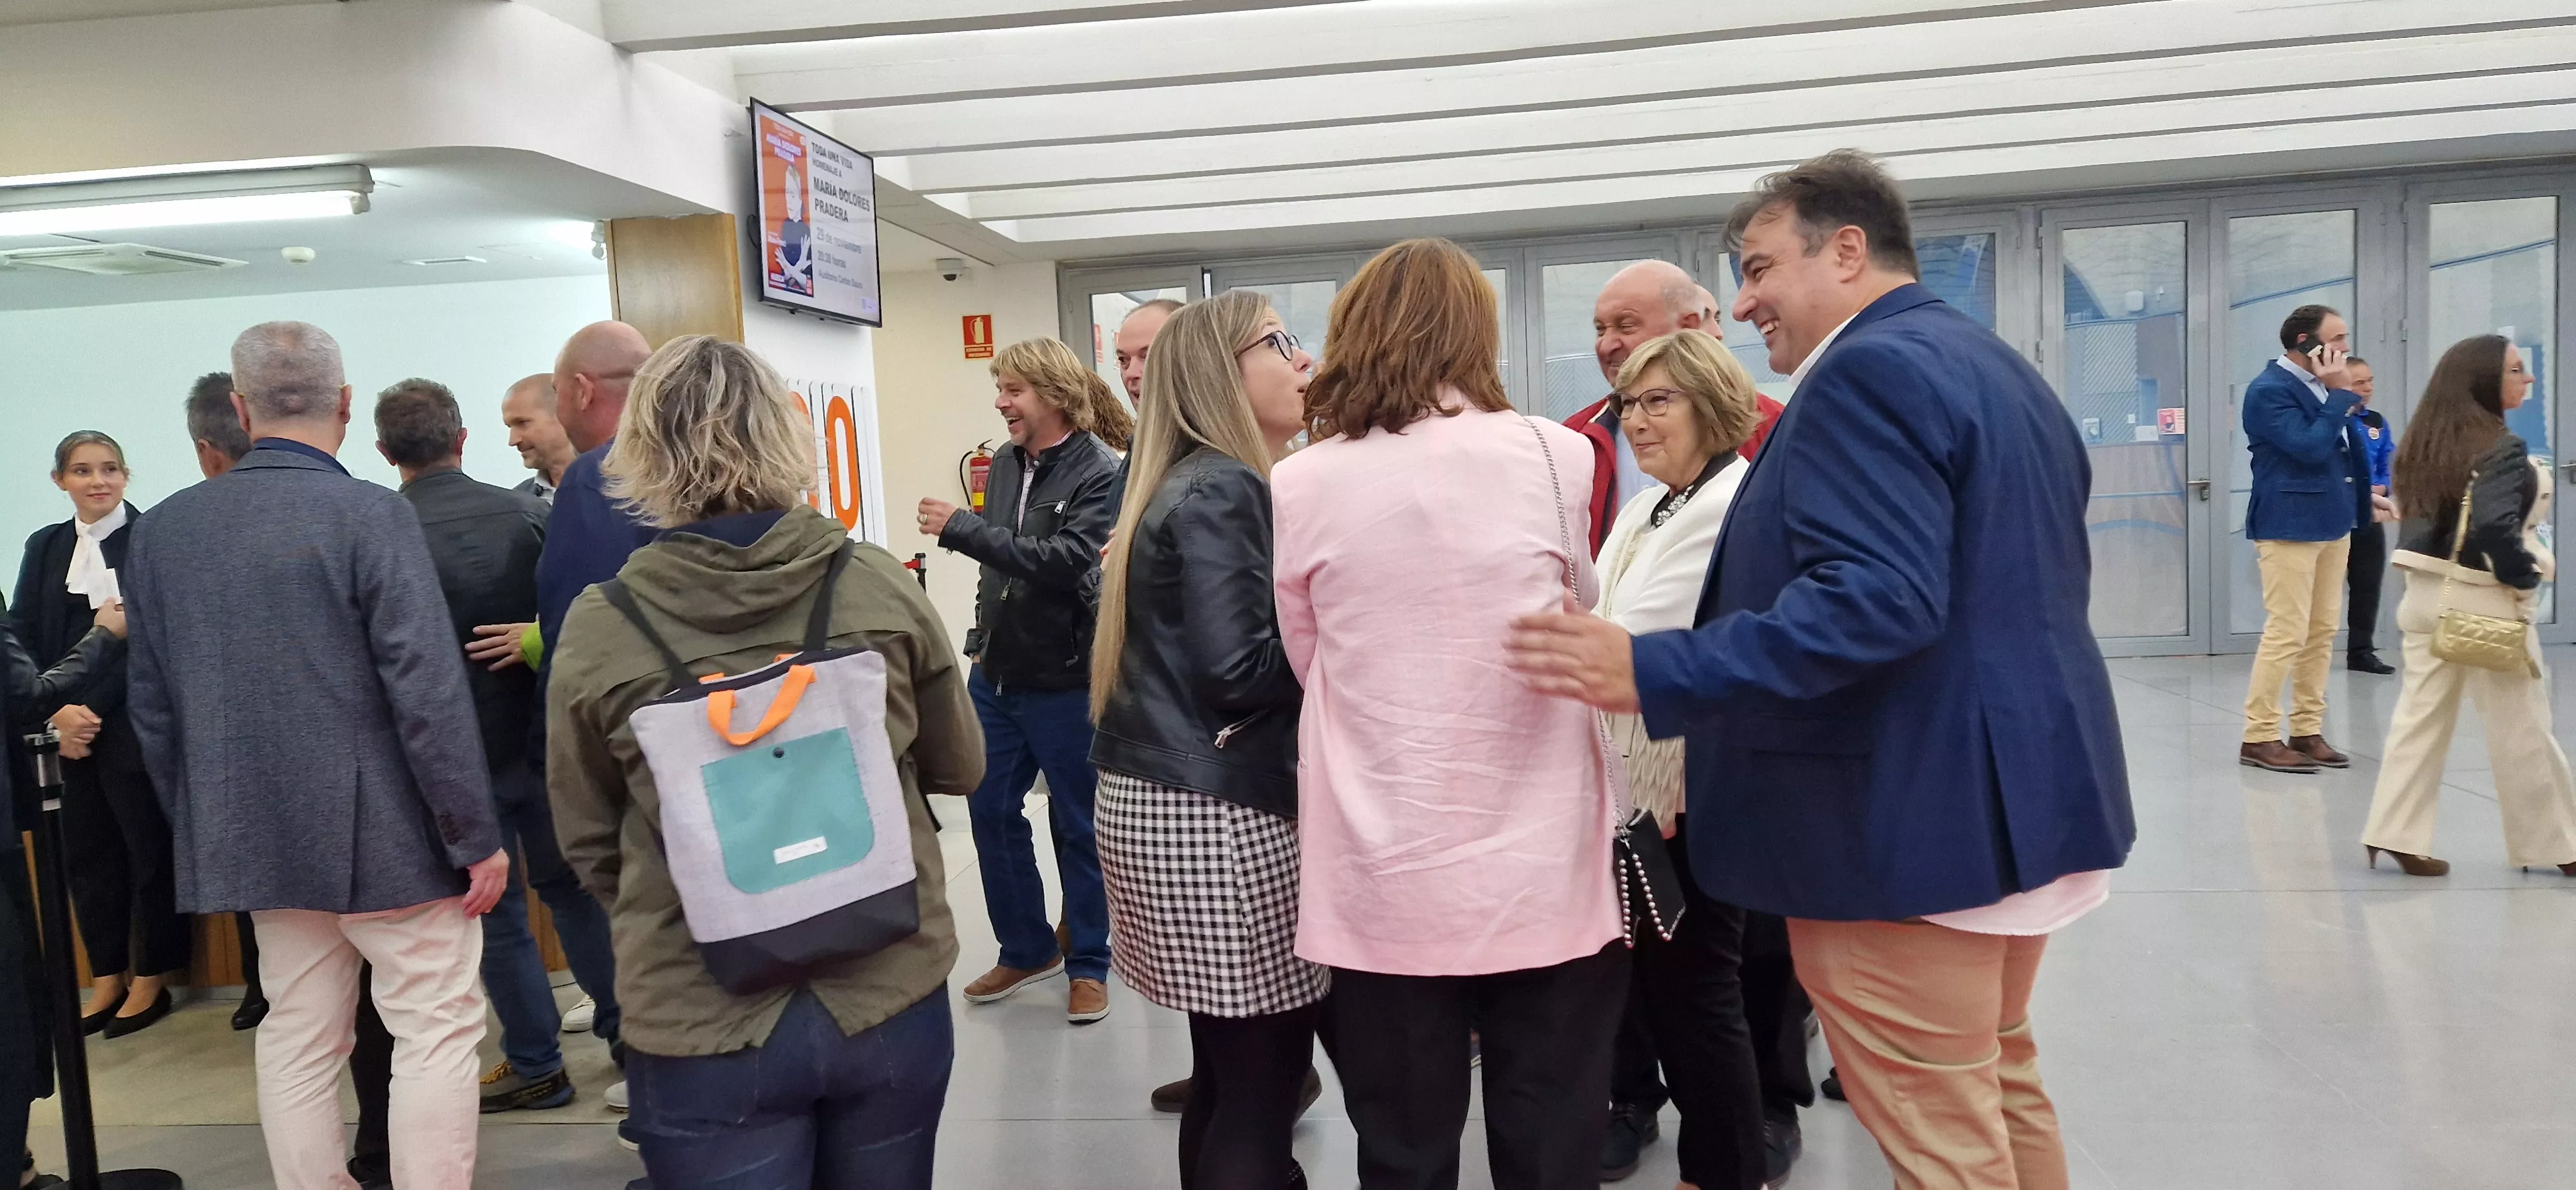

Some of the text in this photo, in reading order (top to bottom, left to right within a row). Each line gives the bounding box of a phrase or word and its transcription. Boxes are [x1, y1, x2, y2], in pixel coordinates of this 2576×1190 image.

[811, 142, 827, 158] TODA
[828, 149, 840, 164] UNA
[815, 198, 849, 223] PRADERA
[839, 187, 870, 212] DOLORES
